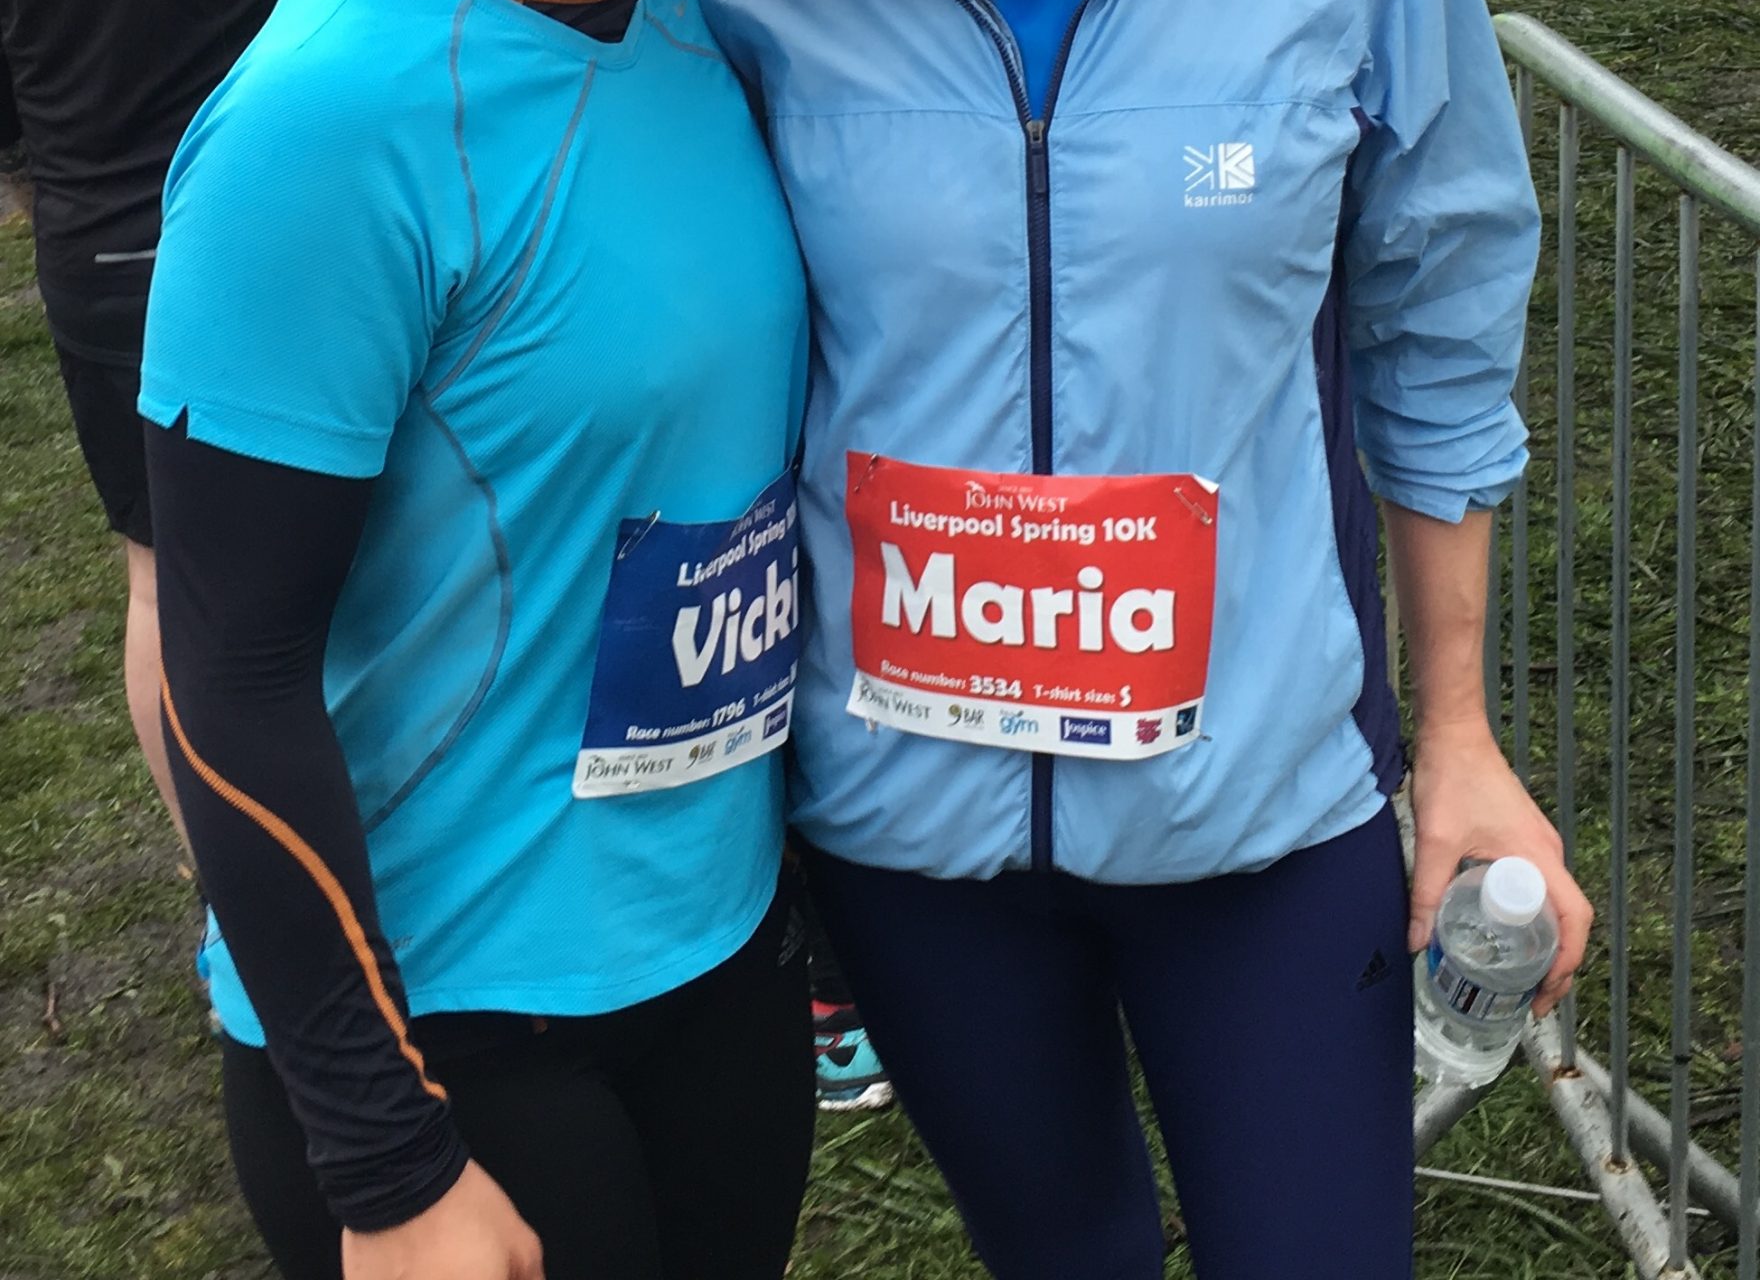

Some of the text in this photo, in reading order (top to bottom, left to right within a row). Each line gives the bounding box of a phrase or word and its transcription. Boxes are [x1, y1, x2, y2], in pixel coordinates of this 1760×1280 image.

[890, 501, 1158, 545] Liverpool Spring 10K
[965, 491, 1069, 513] JOHN WEST
[677, 518, 786, 587] Liverpool Spring
[672, 546, 799, 688] Vicki
[881, 541, 1177, 654] Maria
[881, 659, 909, 680] Race
[969, 675, 1023, 699] 3534
[1033, 684, 1082, 702] T-shirt
[1120, 685, 1132, 707] S
[626, 724, 659, 741] Race
[712, 698, 746, 728] 1796
[892, 696, 932, 719] WEST
[999, 714, 1040, 736] gym
[584, 758, 675, 781] JOHN WEST
